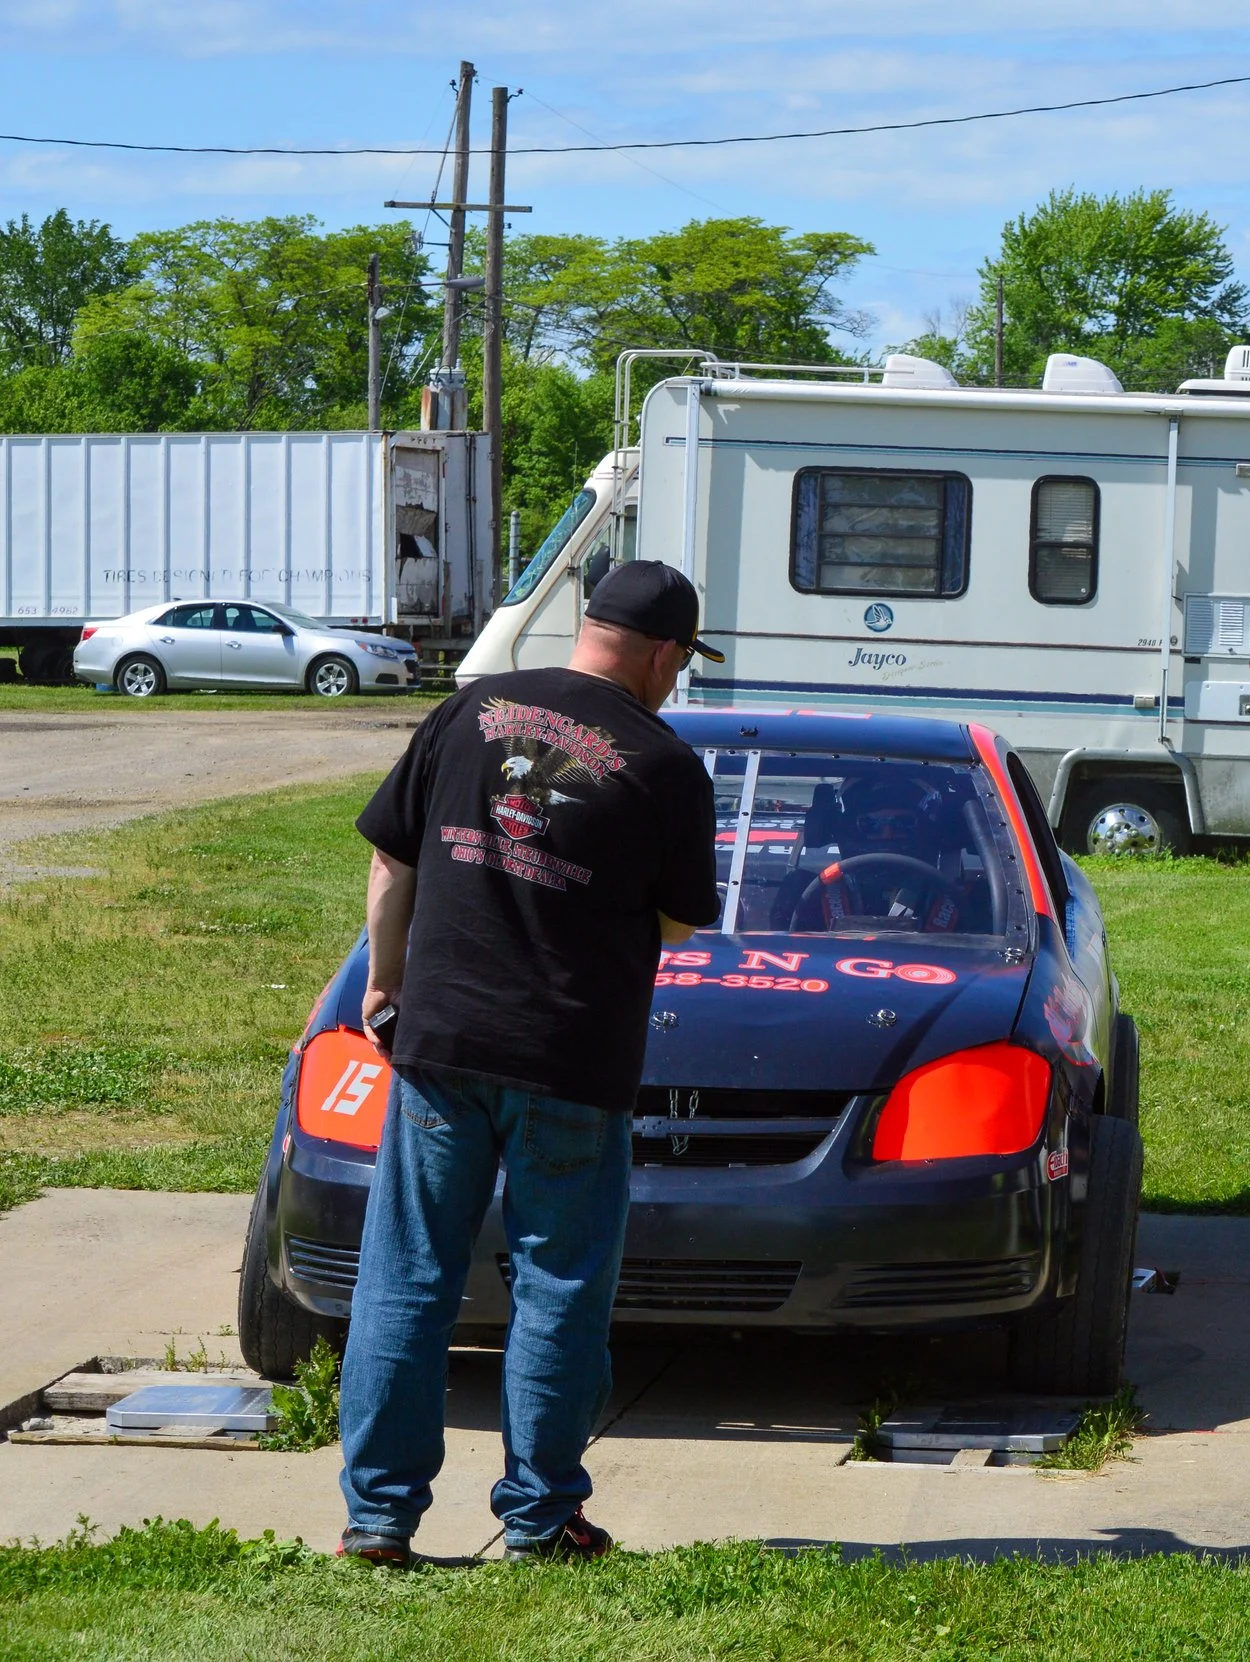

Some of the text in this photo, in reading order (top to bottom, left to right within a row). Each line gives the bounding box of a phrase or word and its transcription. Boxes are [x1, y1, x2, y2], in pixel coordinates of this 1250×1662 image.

[103, 569, 147, 583] TIRES
[848, 648, 906, 670] Jayco
[478, 705, 627, 771] NEIDENGARD'S
[485, 722, 609, 779] HARLEY-DAVIDSON
[495, 804, 543, 829] HARLEY-DAVIDSON
[451, 844, 567, 891] OHIO'S OLDEST DEALER
[513, 841, 592, 884] STEUBENVILLE
[738, 950, 809, 972] N
[320, 1059, 383, 1116] 15
